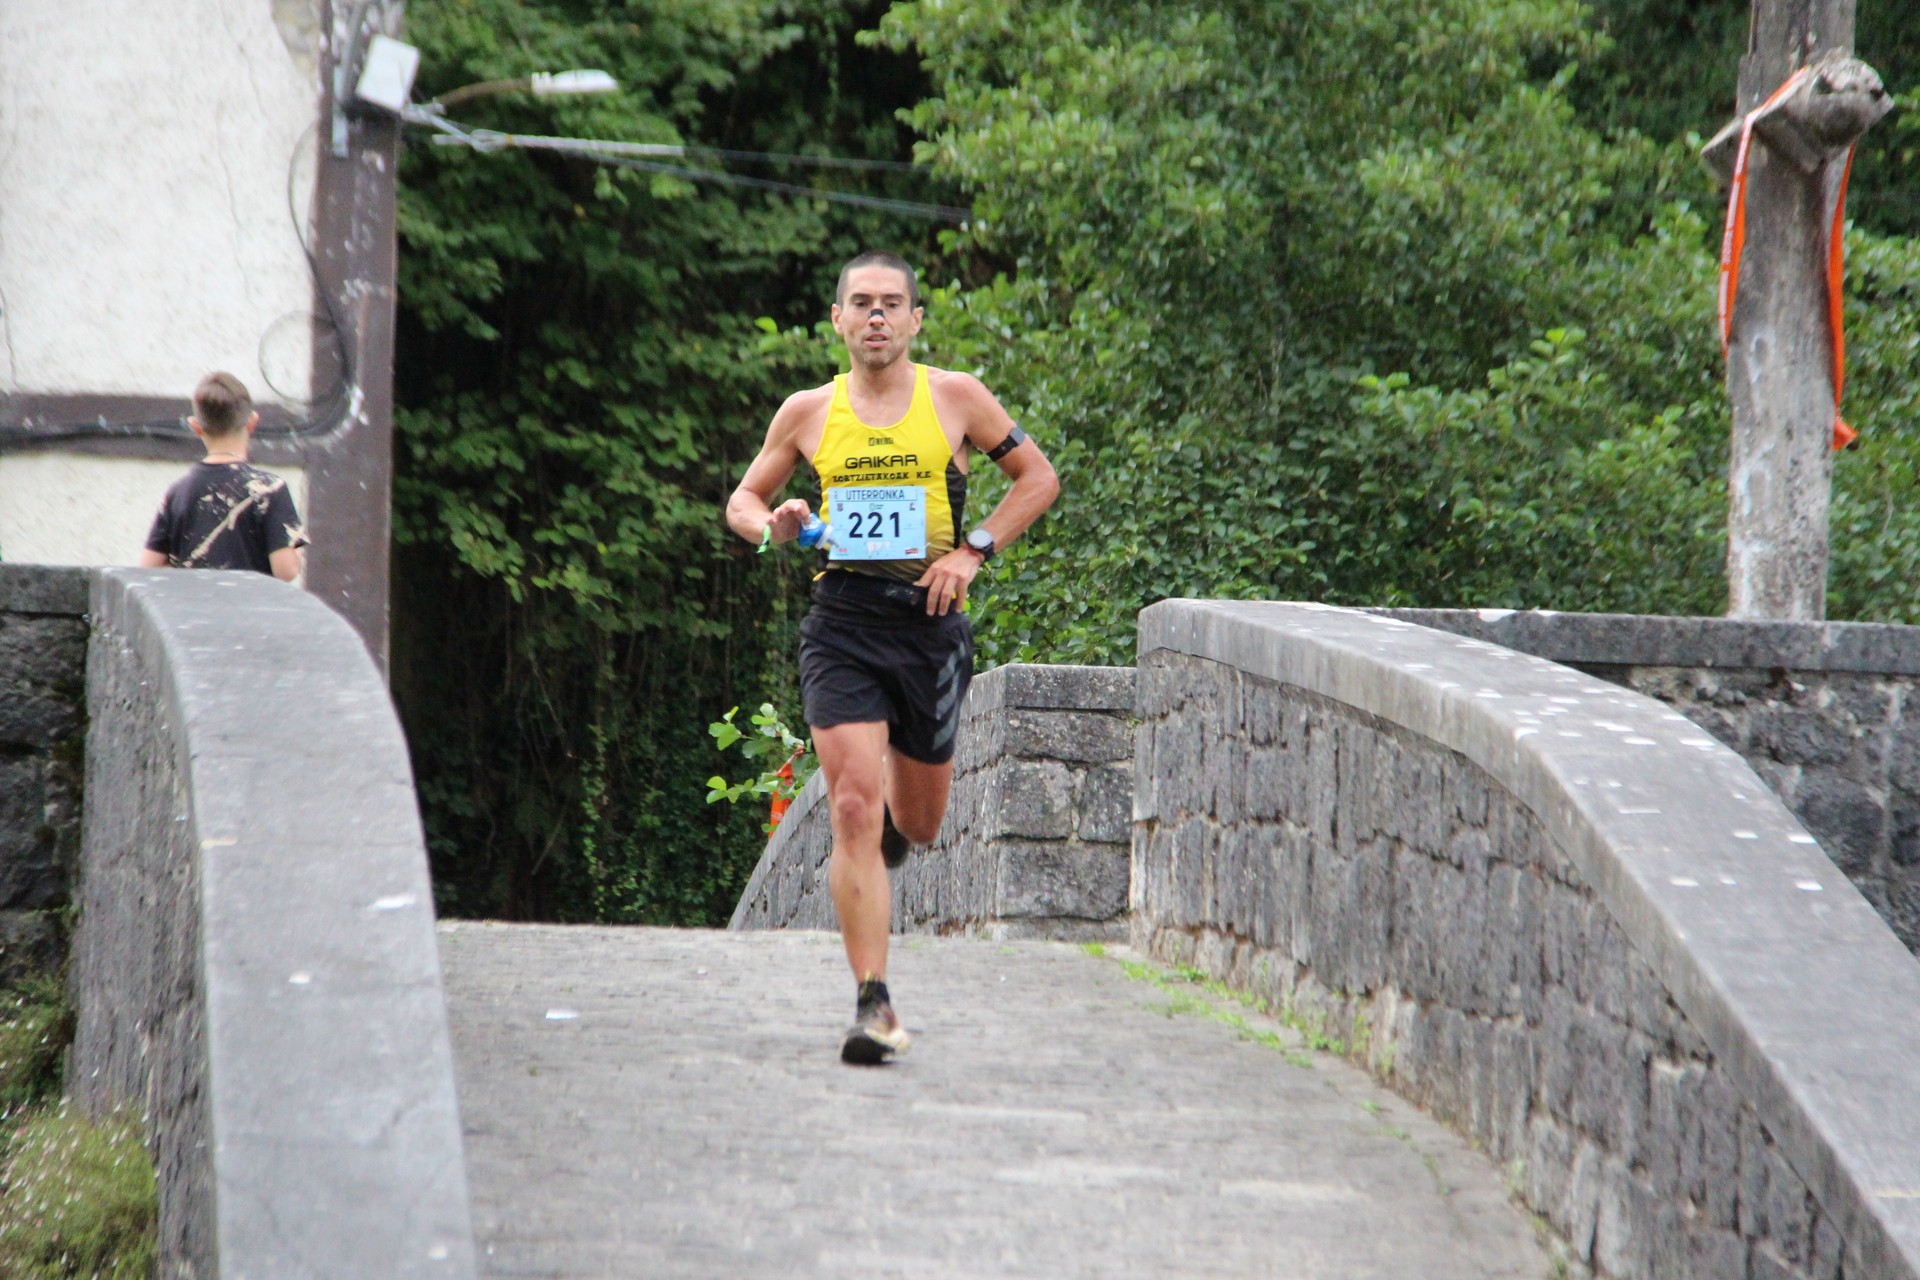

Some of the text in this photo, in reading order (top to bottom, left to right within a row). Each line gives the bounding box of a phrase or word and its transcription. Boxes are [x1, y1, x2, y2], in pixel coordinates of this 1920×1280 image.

[845, 454, 918, 469] GAIKAR
[846, 489, 905, 500] UTTERRONKA
[848, 511, 900, 538] 221
